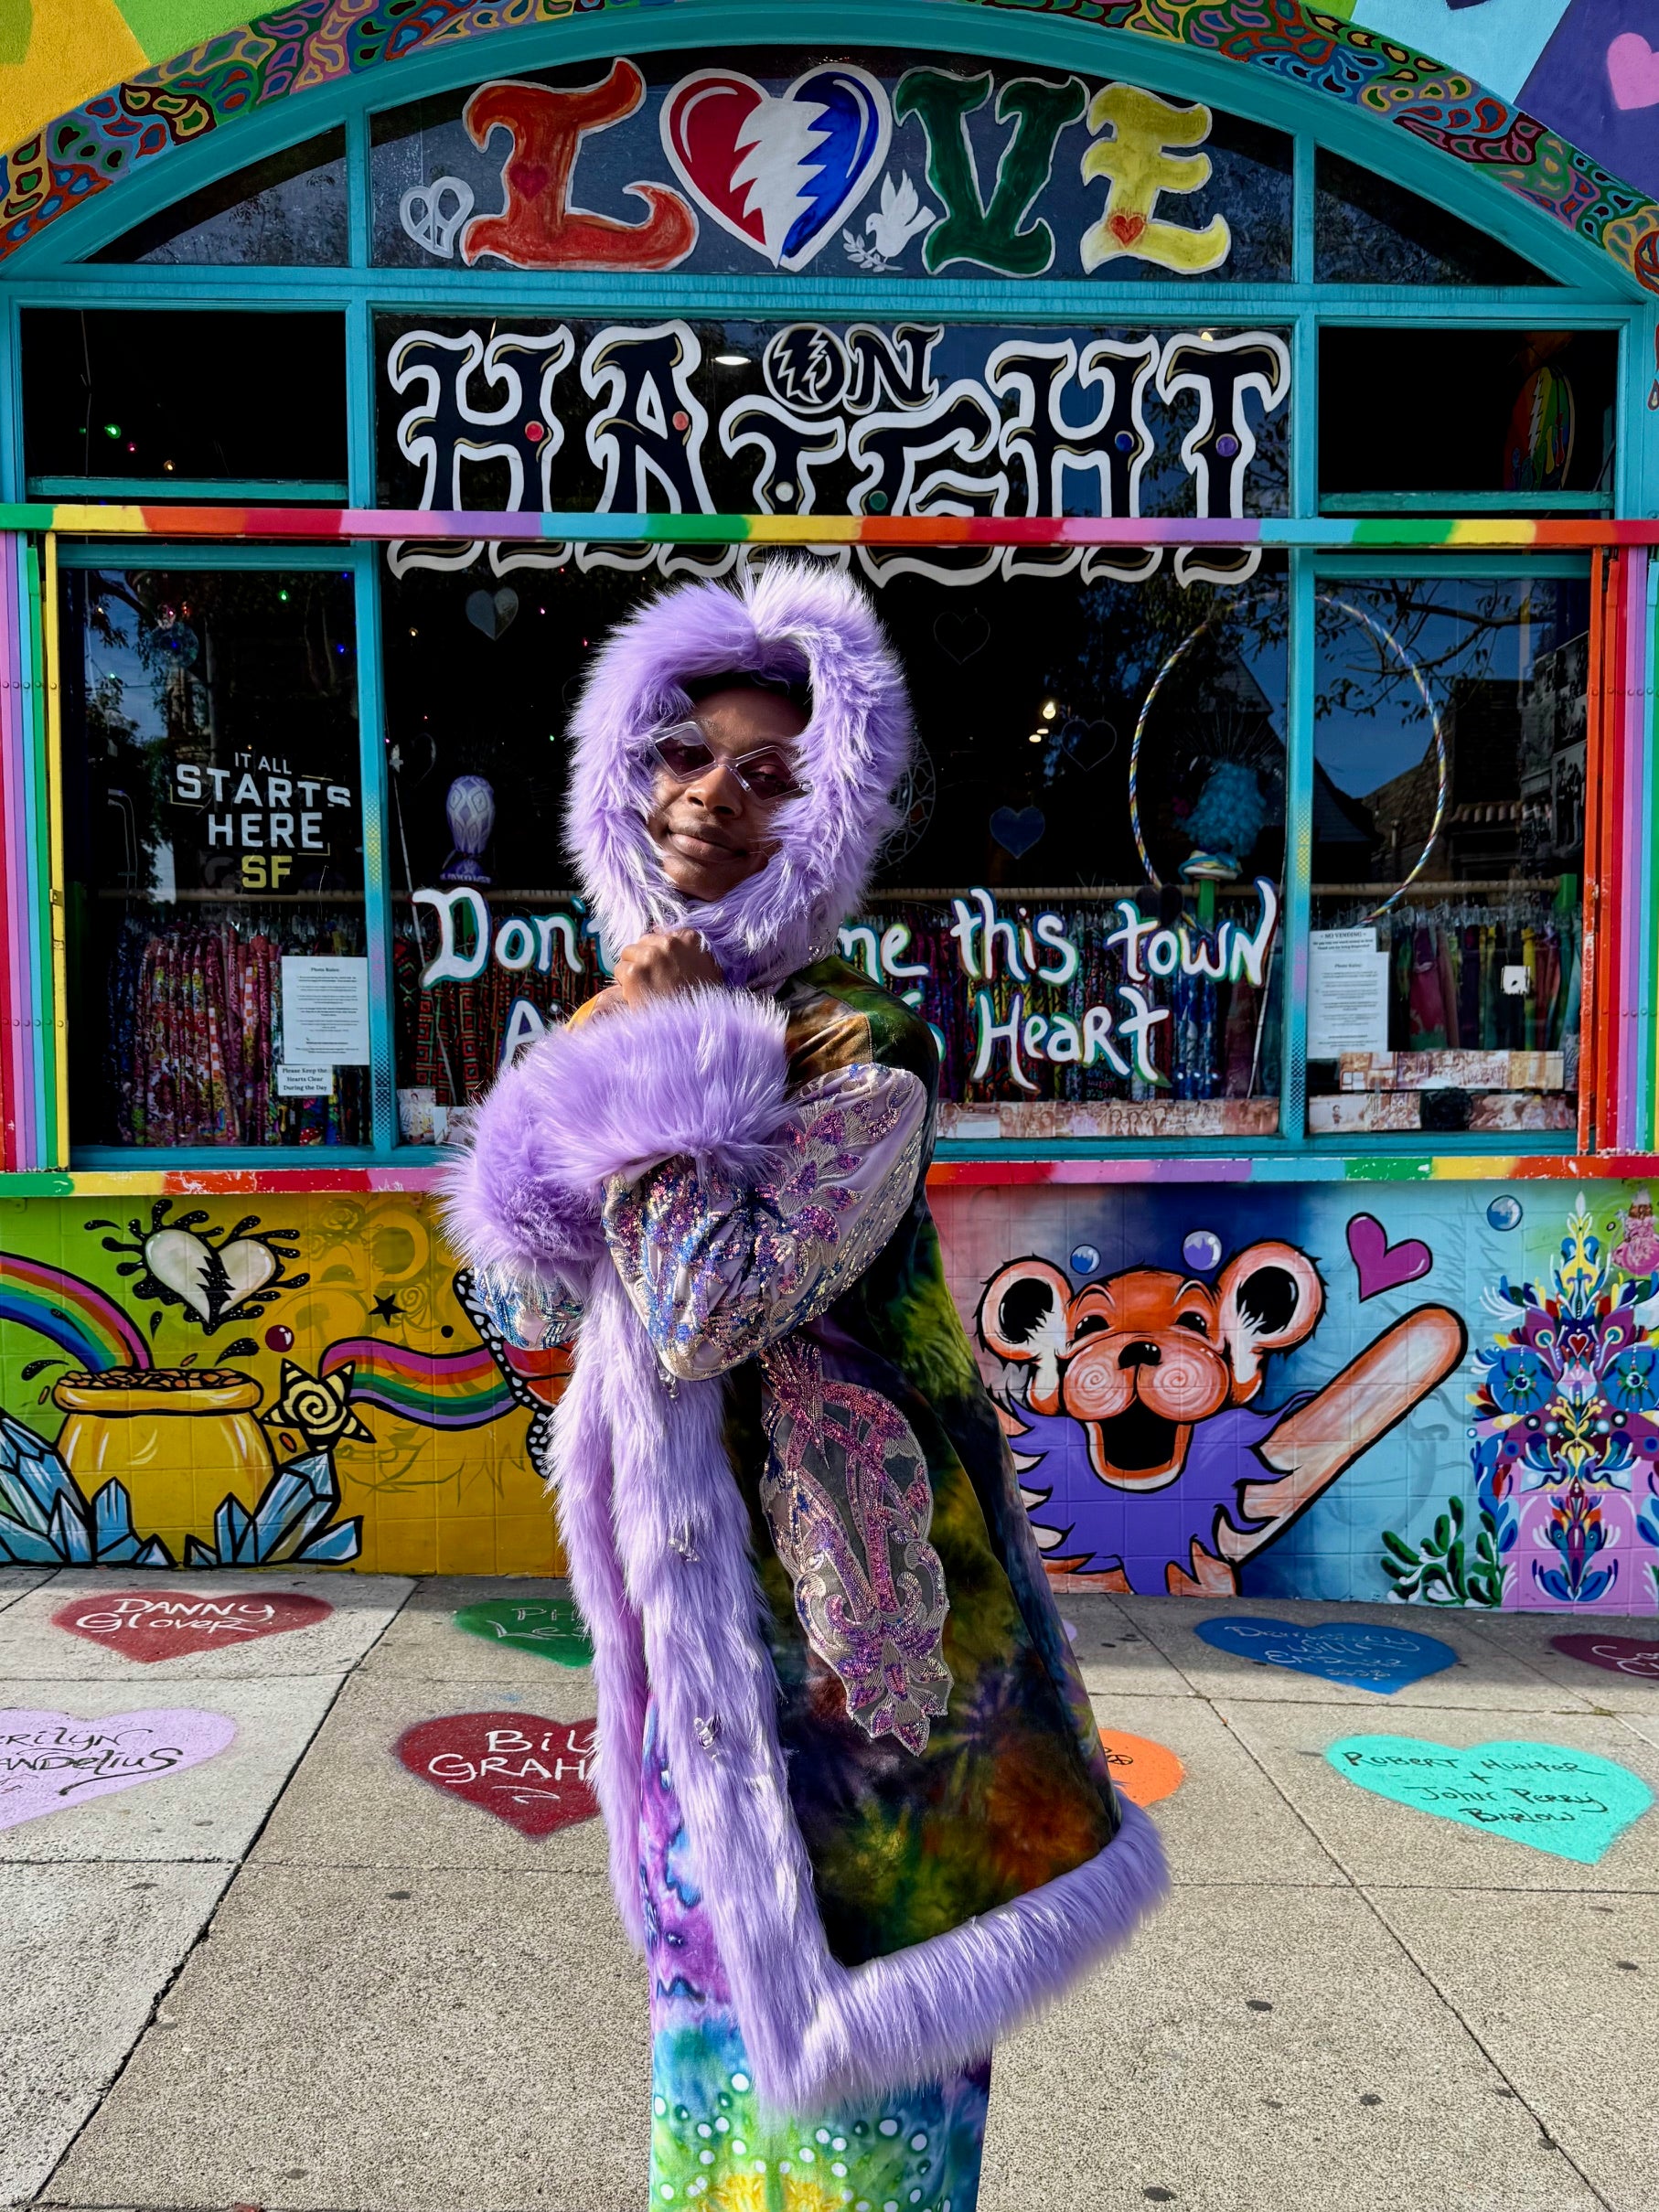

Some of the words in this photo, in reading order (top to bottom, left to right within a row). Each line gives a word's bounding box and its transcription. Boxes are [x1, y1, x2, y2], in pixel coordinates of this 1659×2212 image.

[763, 322, 945, 415] ON
[387, 320, 1290, 587] HAIGHT
[234, 752, 252, 768] IT
[258, 755, 293, 775] ALL
[176, 763, 352, 808] STARTS
[208, 811, 324, 850] HERE
[241, 854, 293, 889] SF
[949, 885, 1081, 987] this
[428, 1753, 587, 1784] GRAH
